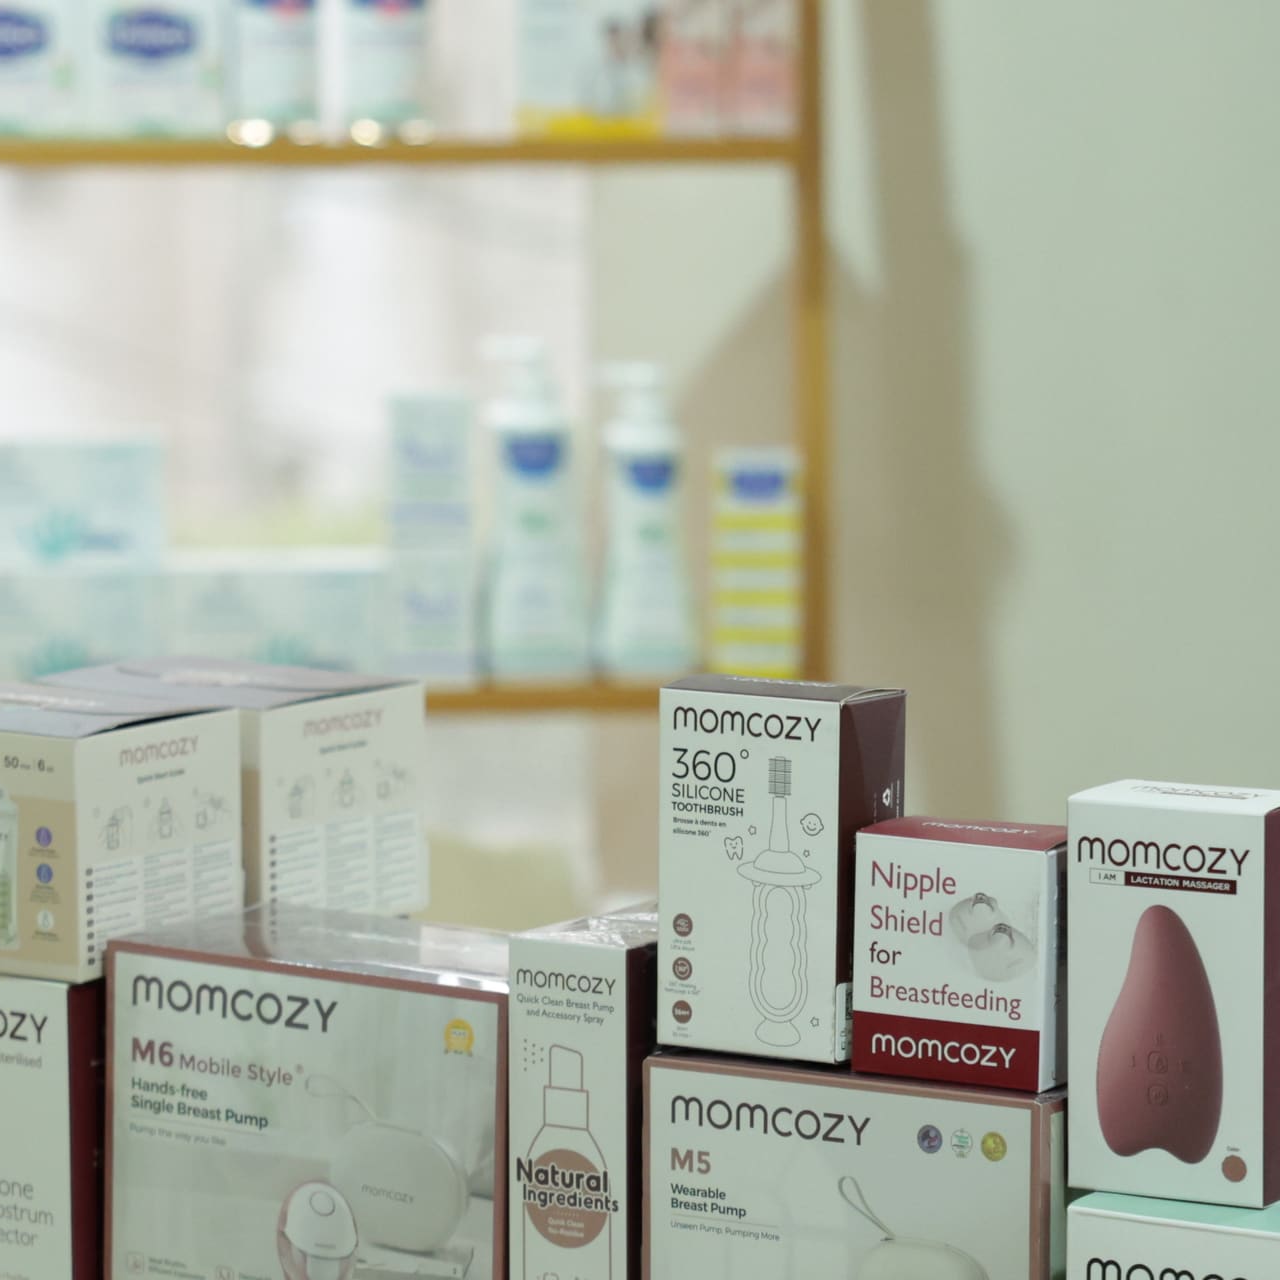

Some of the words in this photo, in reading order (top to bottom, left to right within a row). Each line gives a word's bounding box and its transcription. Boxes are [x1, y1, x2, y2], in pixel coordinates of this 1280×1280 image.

[671, 782, 745, 804] SILICONE
[671, 801, 744, 817] TOOTHBRUSH
[871, 860, 957, 901] Nipple
[1103, 873, 1116, 881] AM
[1130, 875, 1180, 888] LACTATION
[1182, 879, 1231, 891] MASSAGER
[870, 904, 943, 937] Shield
[869, 941, 902, 966] for
[516, 993, 539, 1005] Quick
[541, 995, 564, 1007] Clean
[566, 998, 590, 1011] Breast
[592, 1001, 615, 1014] Pump
[870, 975, 1022, 1021] Breastfeeding
[526, 1008, 541, 1017] and
[541, 1010, 581, 1024] Accessory
[583, 1014, 604, 1026] Spray
[131, 1036, 174, 1068] M6
[179, 1053, 242, 1080] Mobile
[131, 1077, 208, 1101] Hands-free
[131, 1094, 174, 1116] Single
[176, 1101, 221, 1122] Breast
[225, 1108, 269, 1131] Pump
[671, 1146, 711, 1175] M5
[516, 1157, 609, 1194] Natural
[523, 1184, 619, 1213] Ingredients
[670, 1182, 726, 1201] Wearable
[671, 1197, 707, 1214] Breast
[710, 1202, 747, 1219] Pump
[725, 1226, 760, 1240] Pumping
[760, 1231, 780, 1241] More
